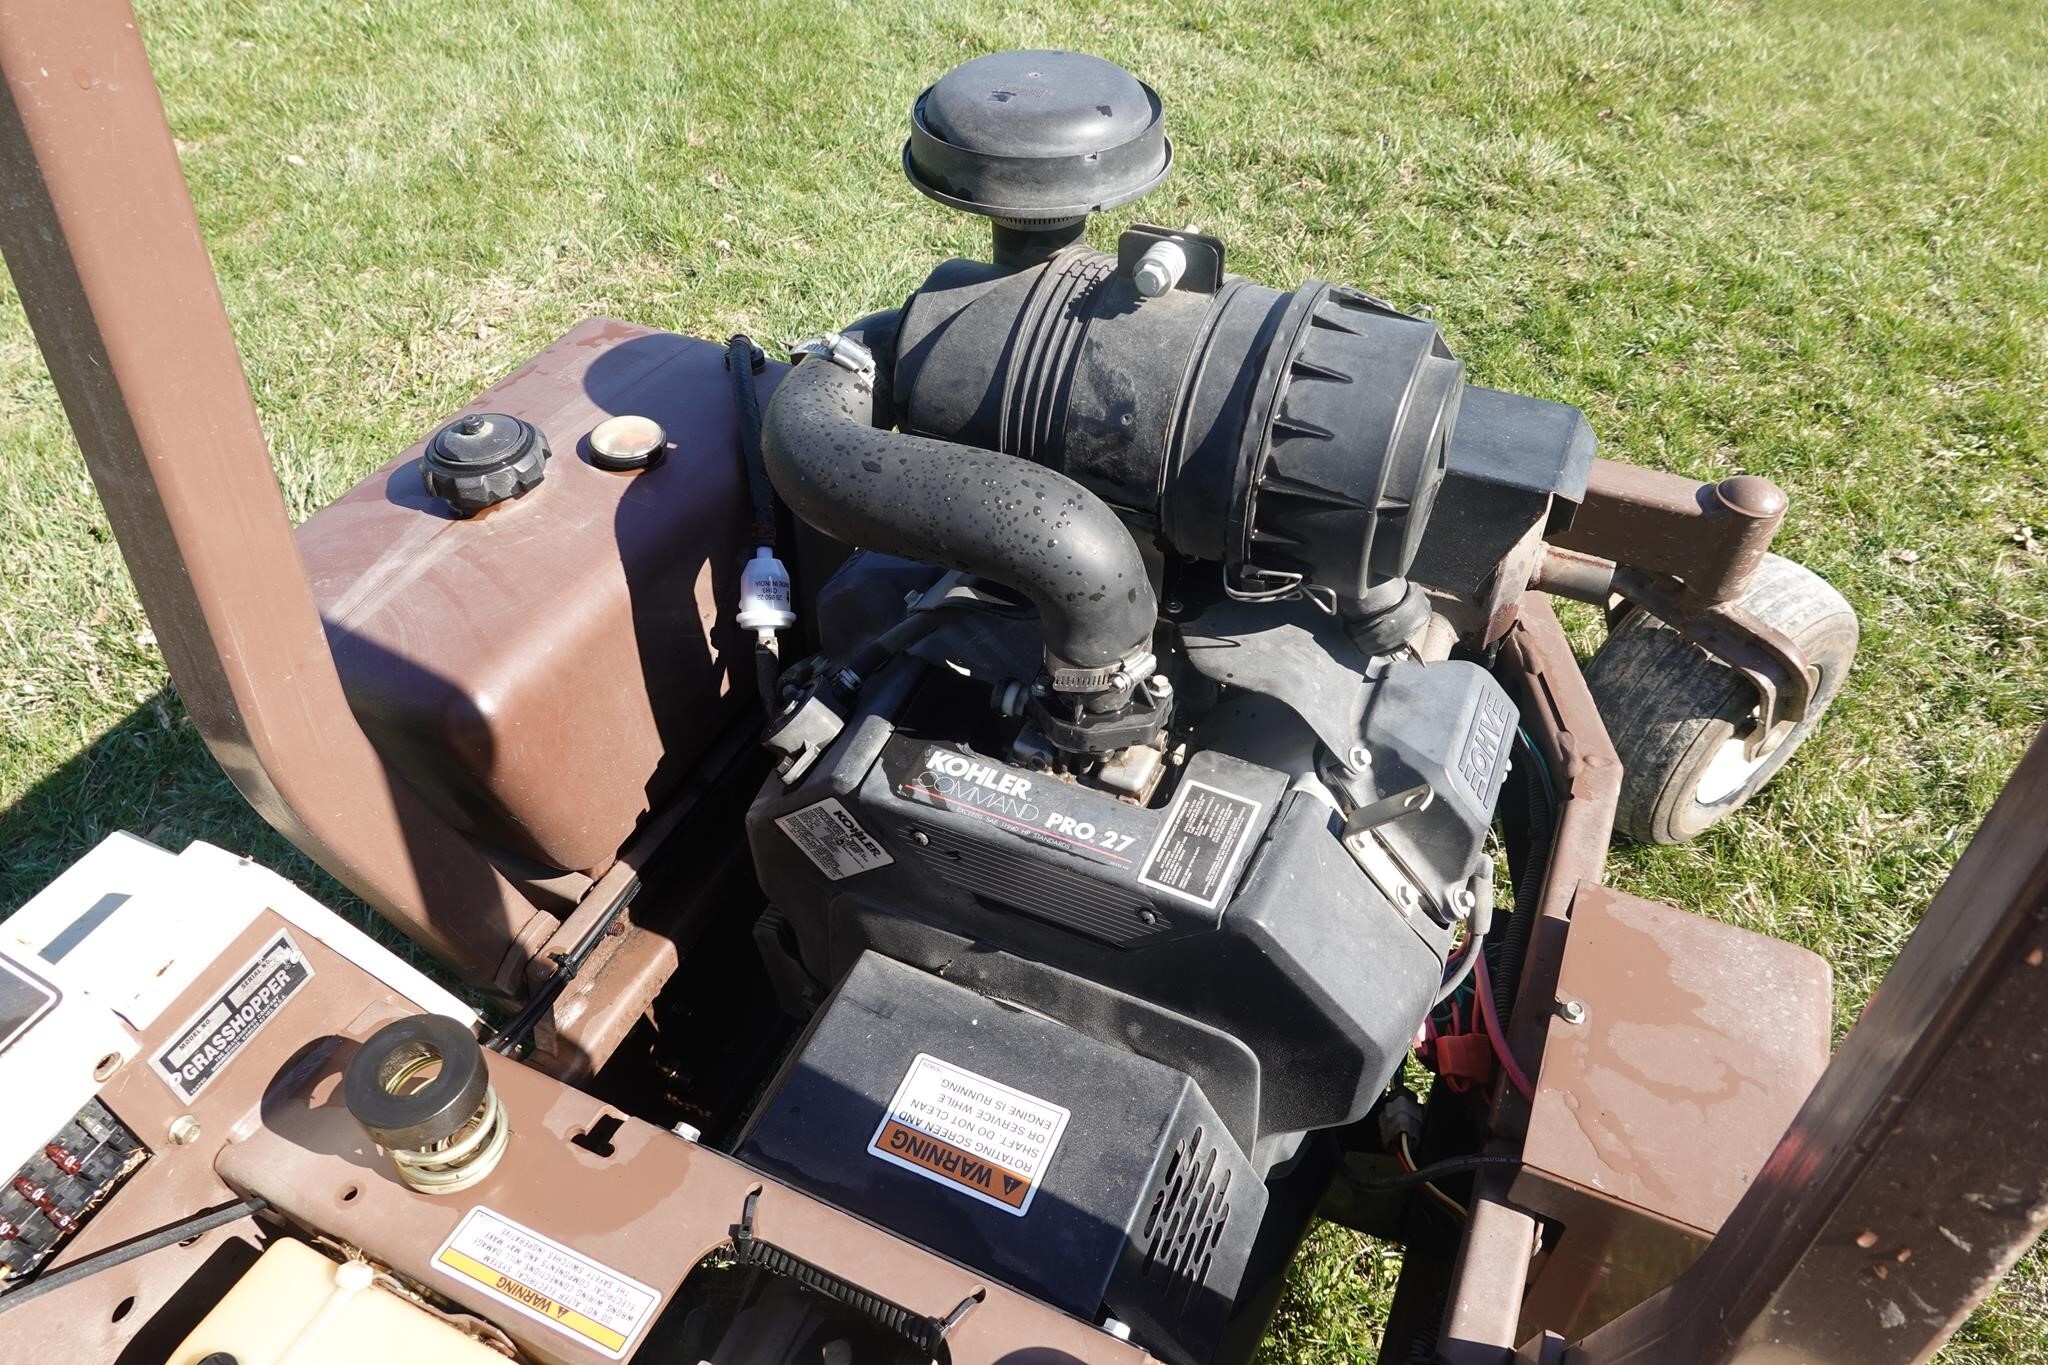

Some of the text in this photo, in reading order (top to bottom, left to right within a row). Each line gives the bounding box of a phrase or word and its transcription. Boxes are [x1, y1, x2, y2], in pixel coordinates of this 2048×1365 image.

[926, 750, 1032, 801] KOHLER
[918, 771, 1040, 822] COMMAND
[833, 810, 882, 860] KOHLER
[1033, 832, 1071, 850] STANDARDS
[1044, 811, 1136, 853] PRO 27
[240, 968, 260, 989] SERIAL
[179, 1029, 200, 1050] MODEL
[180, 967, 290, 1082] GRASSHOPPER
[215, 1050, 225, 1062] THE
[257, 995, 279, 1018] COMPANY
[910, 1098, 949, 1120] CLEAN
[936, 1093, 1045, 1143] OR SERVICE WHILE
[950, 1115, 975, 1131] NOT
[994, 1100, 1006, 1111] IS
[1007, 1105, 1051, 1129] ENGINE
[897, 1110, 1032, 1172] ROTATING SCREEN AND
[976, 1126, 995, 1139] DO
[888, 1129, 995, 1187] WARNING
[472, 1237, 634, 1321] WRONG WIRING CONNECTIONS WILL DAMAGE
[484, 1231, 635, 1310] ELECTRICAL COMPONENTS AND MAY MAKE
[500, 1228, 629, 1296] THE SAFETY SWITCHES INOPERATIVE
[494, 1276, 553, 1311] WARNING
[514, 1270, 557, 1295] ELECTRICAL
[558, 1292, 581, 1307] ALTER
[582, 1304, 598, 1316] NOT
[600, 1313, 612, 1323] DO
